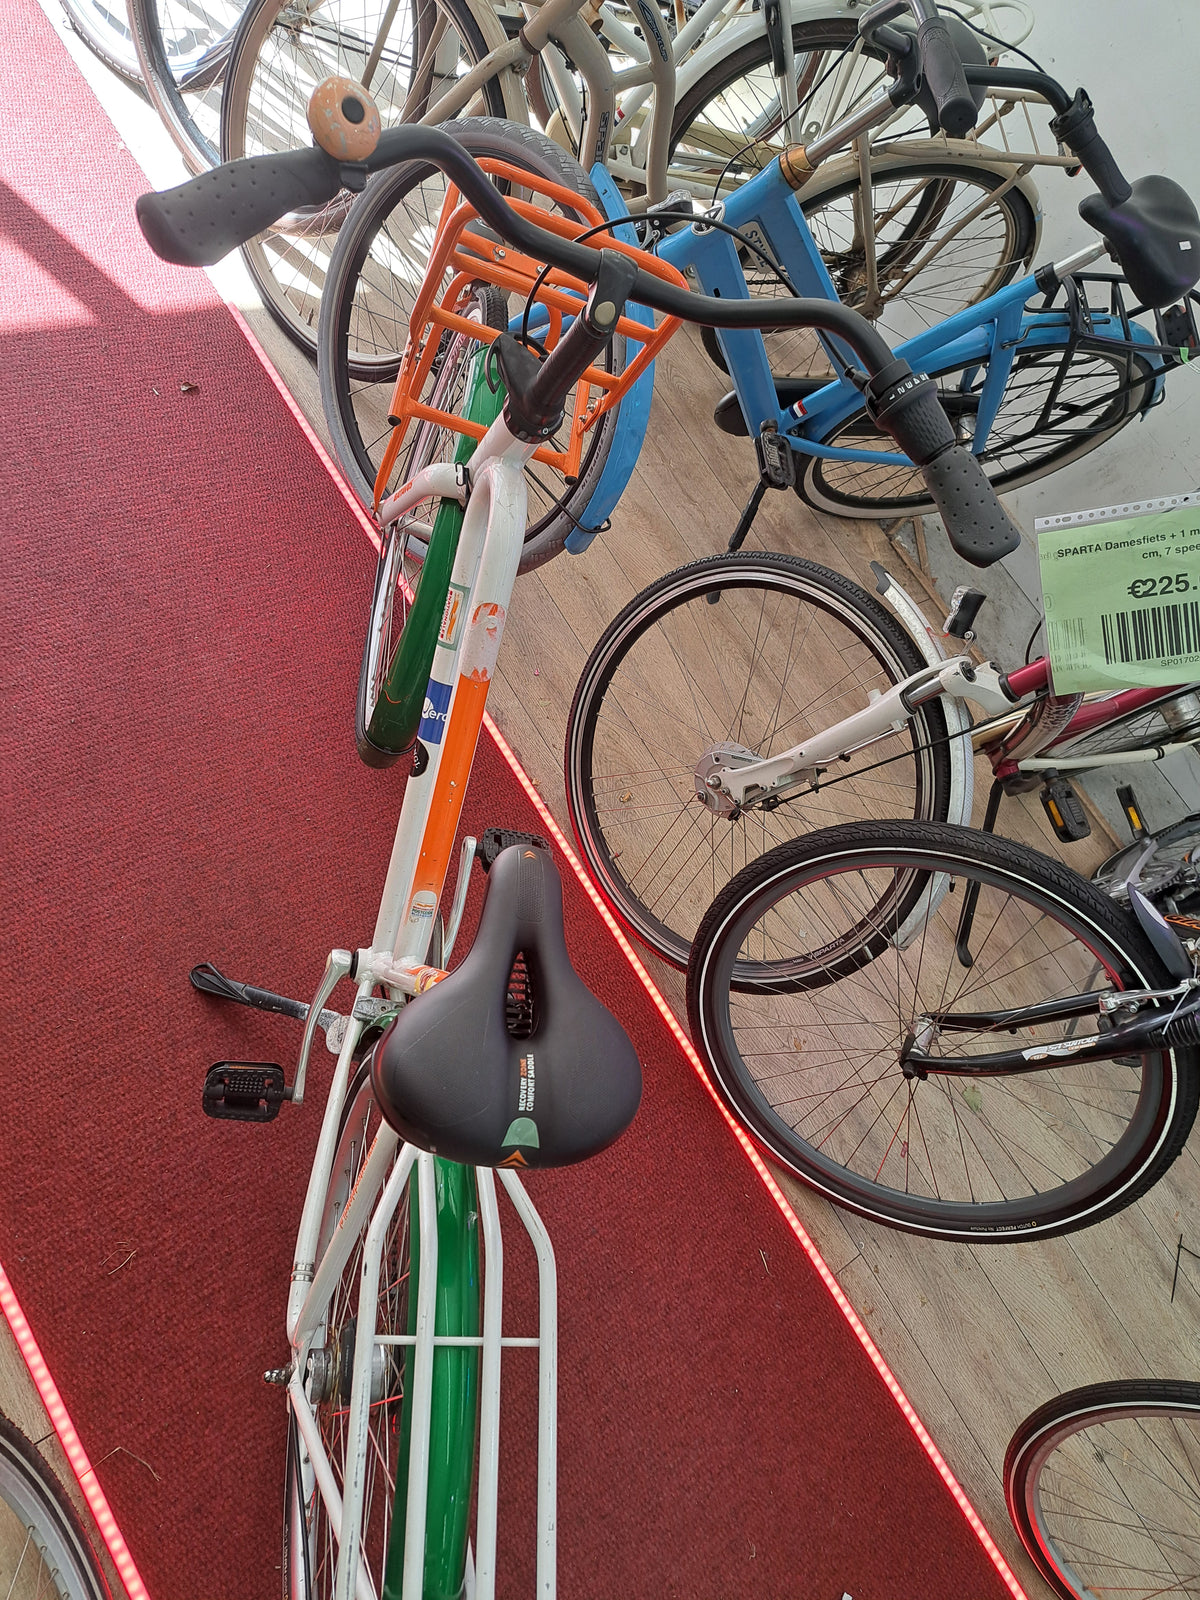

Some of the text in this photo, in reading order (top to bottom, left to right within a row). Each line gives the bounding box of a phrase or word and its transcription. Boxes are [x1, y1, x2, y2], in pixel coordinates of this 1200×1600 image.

[1057, 543, 1102, 558] SPARTA
[1105, 533, 1166, 551] Damesfiets
[1180, 529, 1185, 538] 1
[1142, 550, 1162, 560] cm,
[1165, 546, 1172, 555] 7
[1127, 573, 1200, 599] €225.
[814, 938, 845, 958] SPARTA
[518, 1059, 527, 1111] RECOVERY ZONE
[526, 1054, 535, 1112] COMFORT SADDLE
